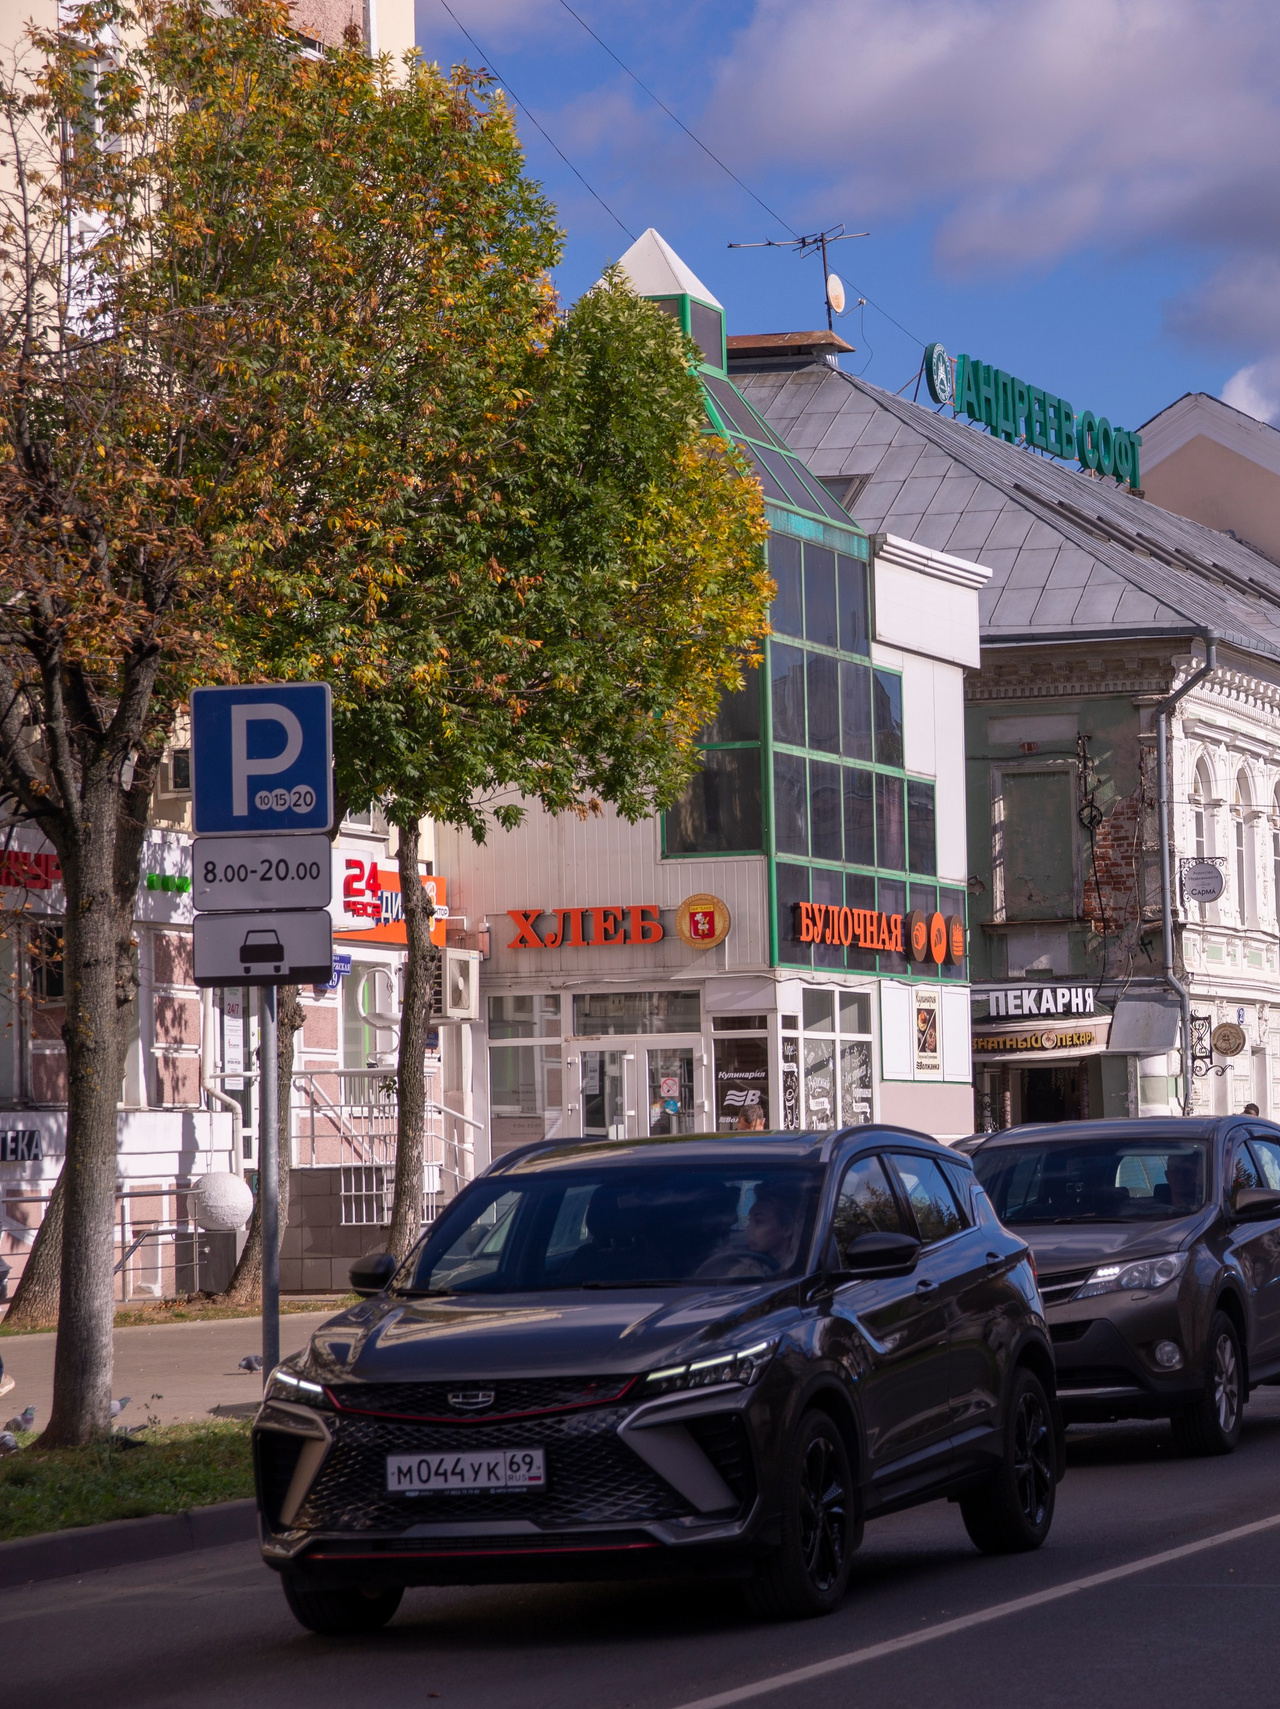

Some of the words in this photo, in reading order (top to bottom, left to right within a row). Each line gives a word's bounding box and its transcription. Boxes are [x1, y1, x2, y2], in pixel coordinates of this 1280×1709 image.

[954, 354, 1076, 460] АНДРЕЕВ
[1076, 410, 1142, 489] СОФТ
[231, 704, 303, 816] P
[259, 796, 270, 806] 10
[274, 794, 287, 806] 15
[292, 791, 314, 807] 20
[204, 859, 321, 883] 8.00-20.00
[343, 859, 381, 897] 24
[507, 905, 664, 949] ХЛЕБ
[800, 901, 903, 952] БУЛОЧНАЯ
[989, 987, 1094, 1016] ПЕКАРНЯ
[397, 1458, 500, 1485] М044УК
[509, 1454, 534, 1473] 69
